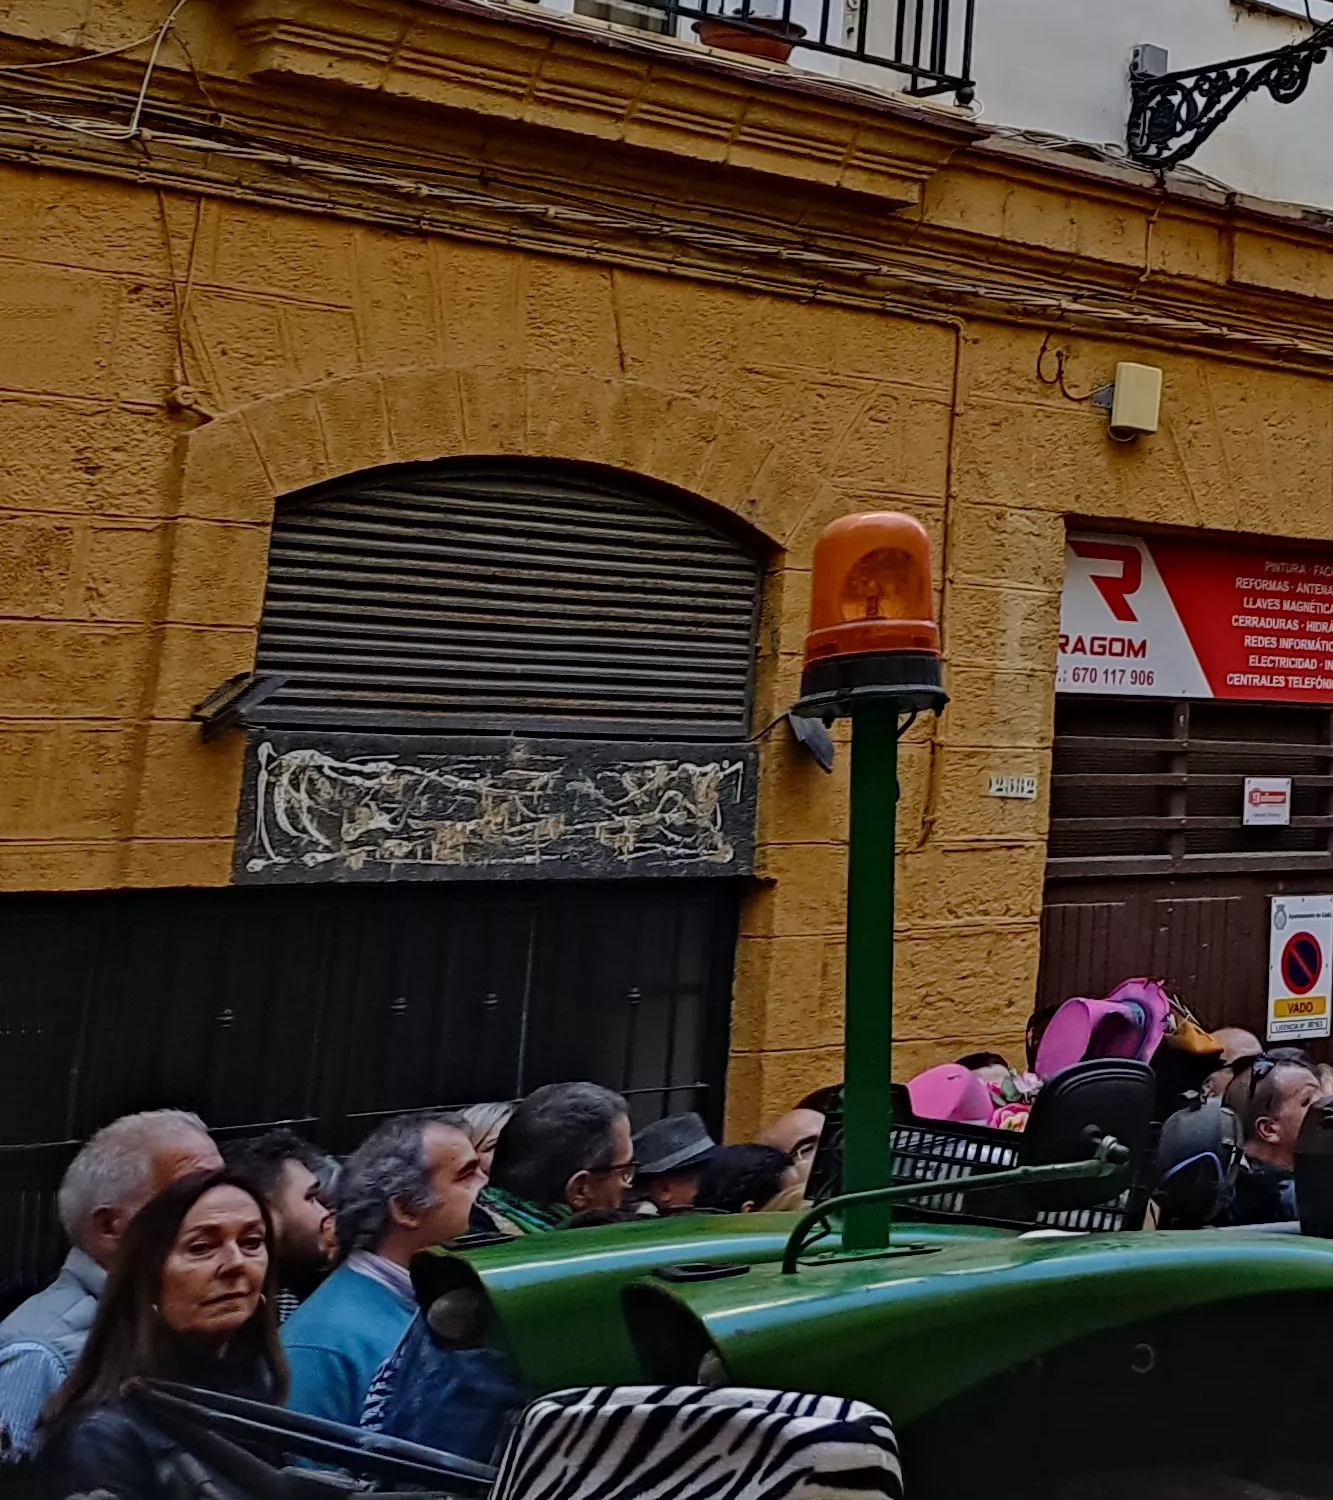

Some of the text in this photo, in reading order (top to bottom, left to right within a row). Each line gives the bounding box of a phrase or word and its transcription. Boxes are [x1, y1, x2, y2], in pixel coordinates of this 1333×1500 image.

[1265, 561, 1306, 574] PINTURA
[1067, 541, 1142, 622] R
[1235, 577, 1289, 592] REFORMAS
[1243, 597, 1280, 610] LLAVES
[1232, 615, 1299, 630] CERRADURAS
[1244, 635, 1277, 648] REDES
[1249, 655, 1317, 670] ELECTRICIDAD
[1072, 667, 1097, 683] 670
[1103, 668, 1126, 685] 117
[1130, 670, 1155, 686] 906
[1227, 673, 1285, 687] CENTRALES
[1288, 1002, 1313, 1014] VADO
